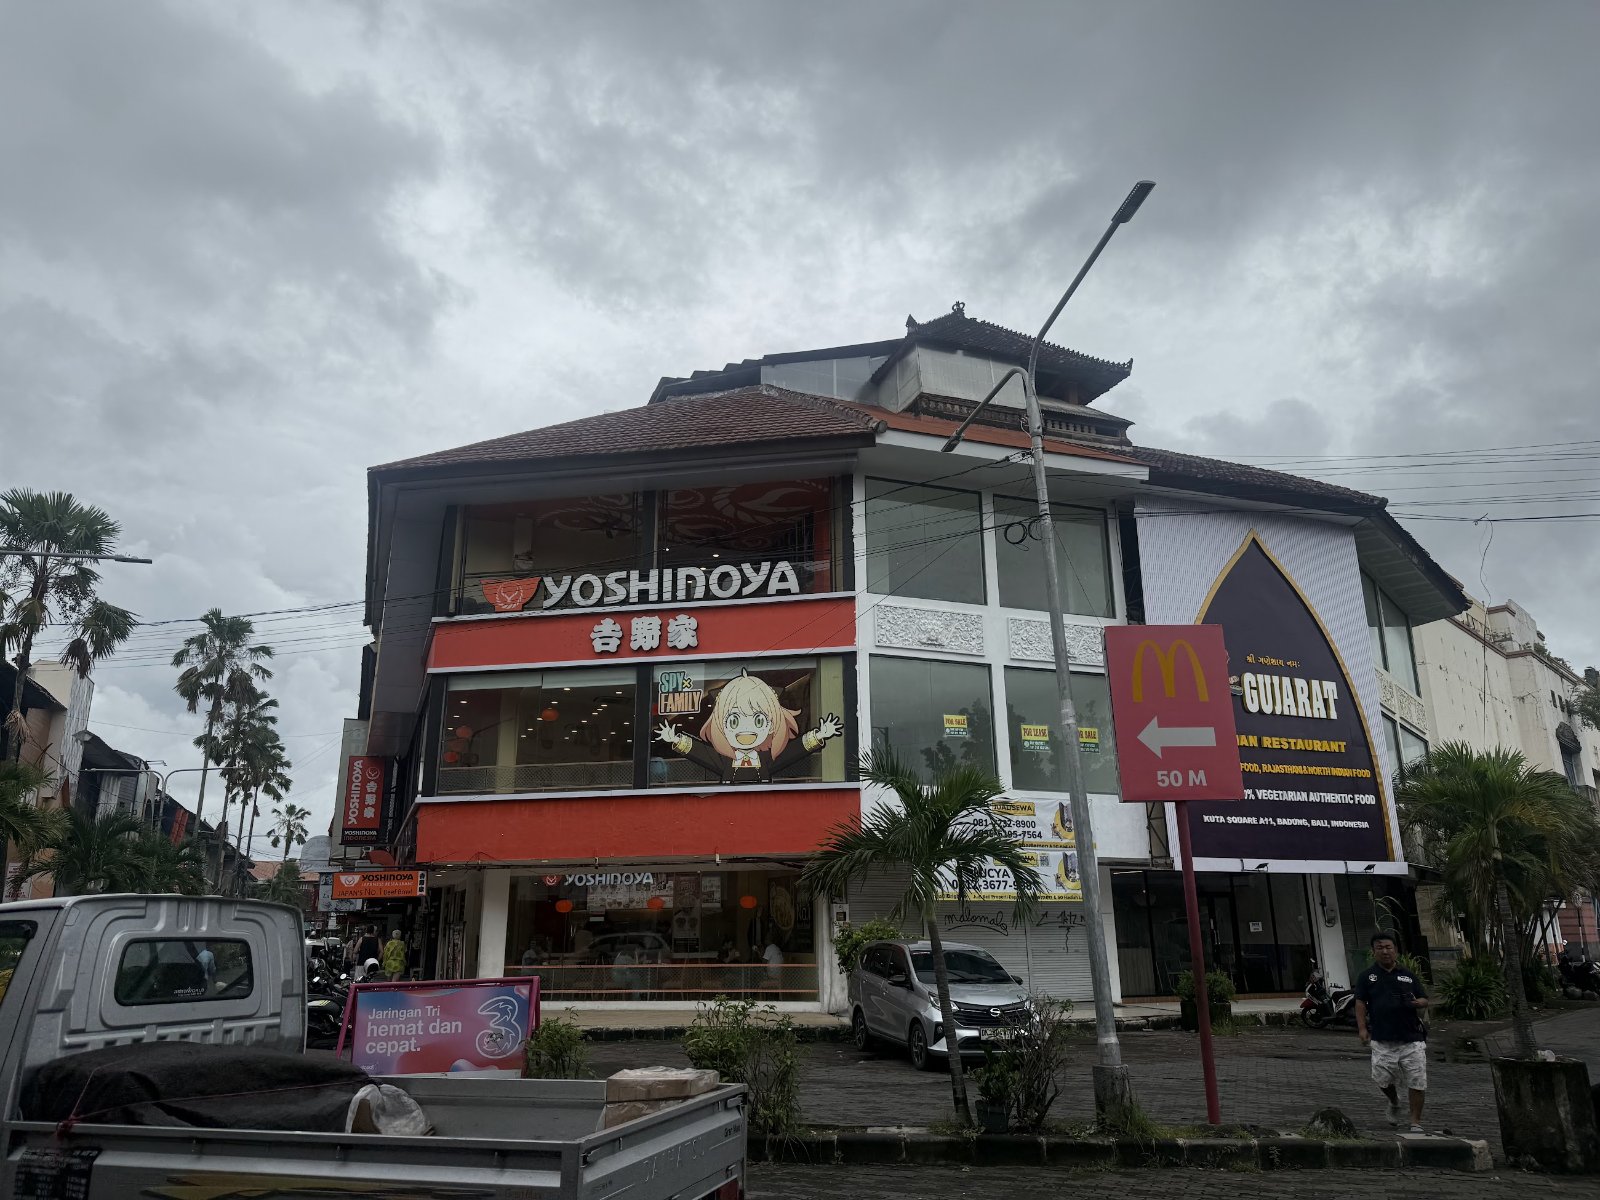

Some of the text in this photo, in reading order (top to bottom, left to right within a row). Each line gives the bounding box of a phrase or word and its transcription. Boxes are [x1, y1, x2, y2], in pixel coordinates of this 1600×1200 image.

[542, 561, 800, 609] YOSHINOYA
[590, 614, 698, 654] 吉野家
[660, 692, 701, 713] FAMILY
[1241, 672, 1338, 719] GUJARAT
[955, 718, 966, 726] SALE
[1023, 727, 1048, 737] FOR LEASE
[1084, 730, 1097, 739] SALE
[1261, 736, 1346, 753] RESTAURANT
[1157, 769, 1207, 787] 50 M
[1240, 762, 1261, 774] FOOD,
[1354, 768, 1371, 778] FOOD
[347, 759, 363, 825] YOSHINOYA
[1256, 789, 1308, 802] VEGETARIAN
[1309, 791, 1354, 804] AUTHENTIC
[1354, 793, 1376, 805] FOOD
[1203, 814, 1369, 829] KUTA SQUARE A11, BADUNG, BALI, INDONESIA
[361, 873, 414, 882] YOSHINOYA
[564, 872, 654, 886] YOSHINOYA
[338, 889, 363, 897] JAPAN'S
[368, 1006, 440, 1021] Jaringan Tri
[367, 1018, 462, 1037] hemat dan
[365, 1037, 421, 1056] cepat.
